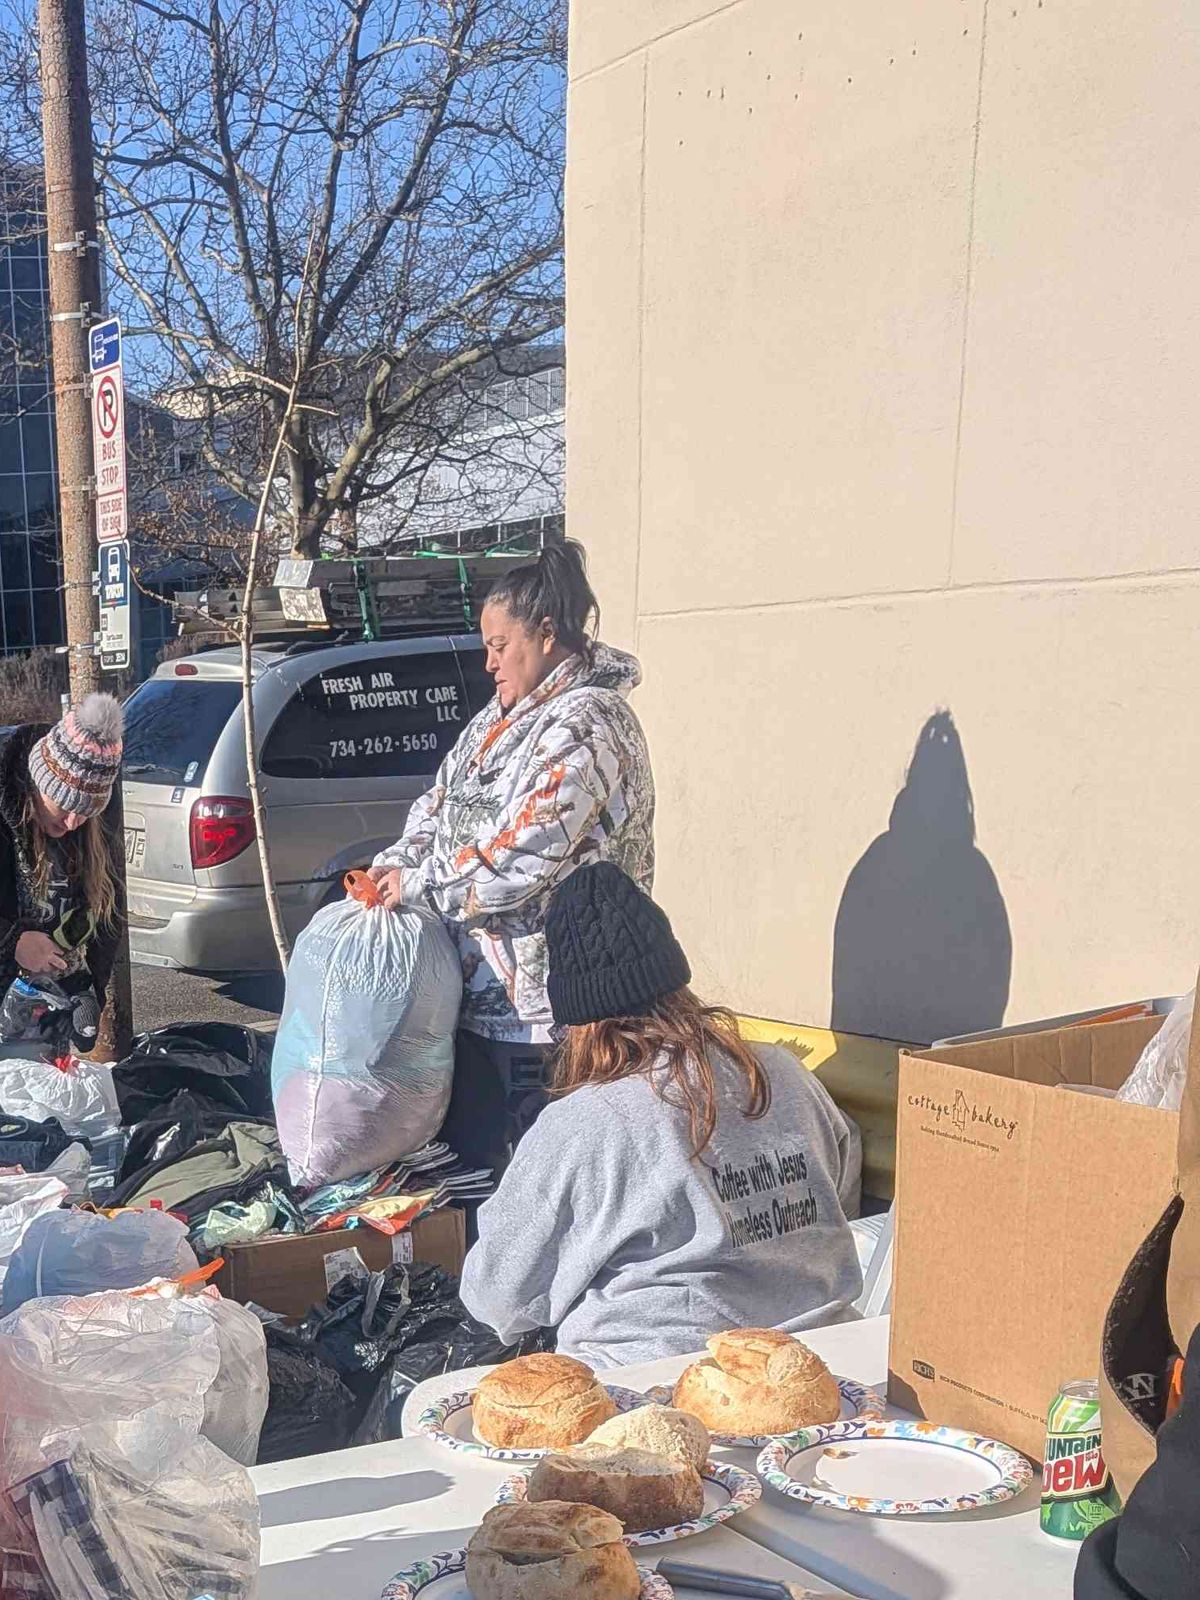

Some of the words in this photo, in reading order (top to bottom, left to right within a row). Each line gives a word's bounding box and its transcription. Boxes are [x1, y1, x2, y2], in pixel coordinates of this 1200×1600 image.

[102, 442, 117, 460] BUS
[101, 466, 119, 485] STOP
[321, 675, 363, 695] FRESH
[371, 672, 395, 689] AIR
[349, 689, 418, 711] PROPERTY
[425, 686, 458, 704] CARE
[436, 706, 461, 722] LLC
[908, 1095, 950, 1122] cottage
[711, 1163, 750, 1203] Coffee
[749, 1153, 778, 1193] with
[774, 1150, 808, 1186] Jesus
[725, 1207, 773, 1249] Homeless
[772, 1188, 818, 1236] Outreach
